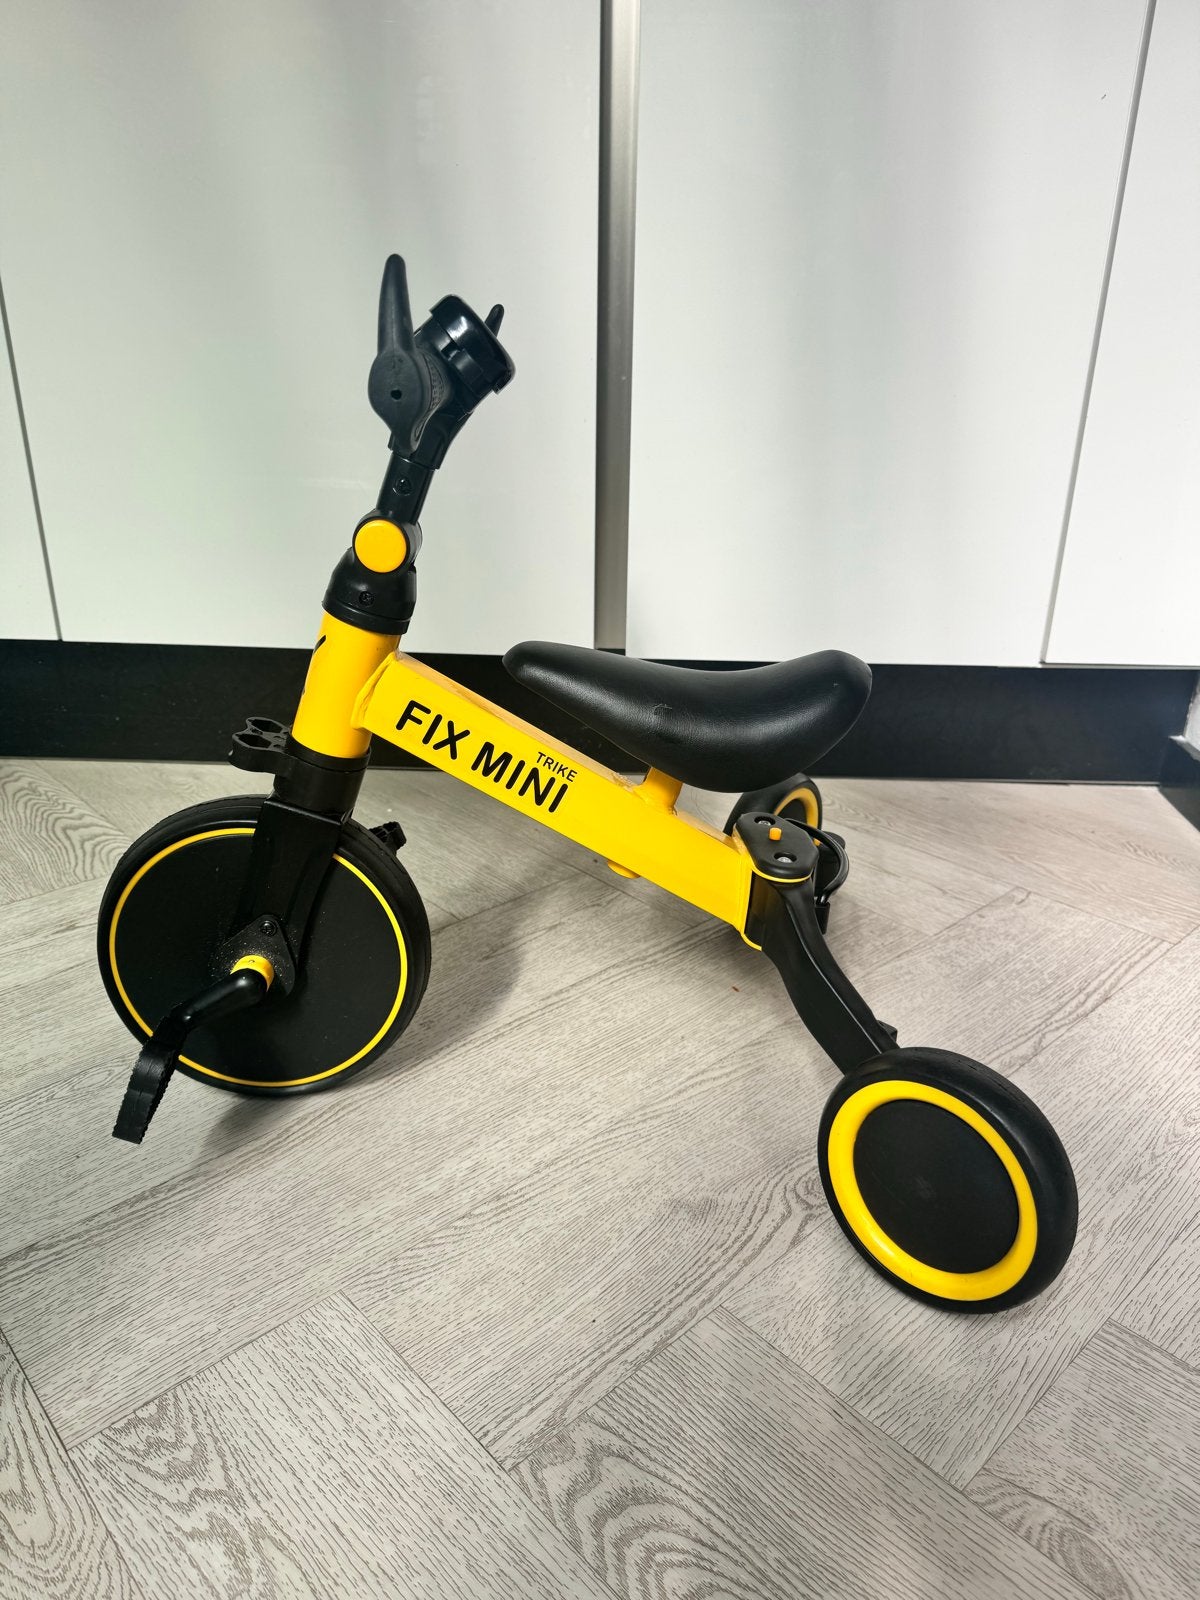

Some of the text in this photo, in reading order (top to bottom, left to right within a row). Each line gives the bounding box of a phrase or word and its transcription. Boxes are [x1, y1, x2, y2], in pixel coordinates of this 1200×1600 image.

[395, 700, 568, 813] FIX MINI
[536, 751, 578, 783] TRIKE
